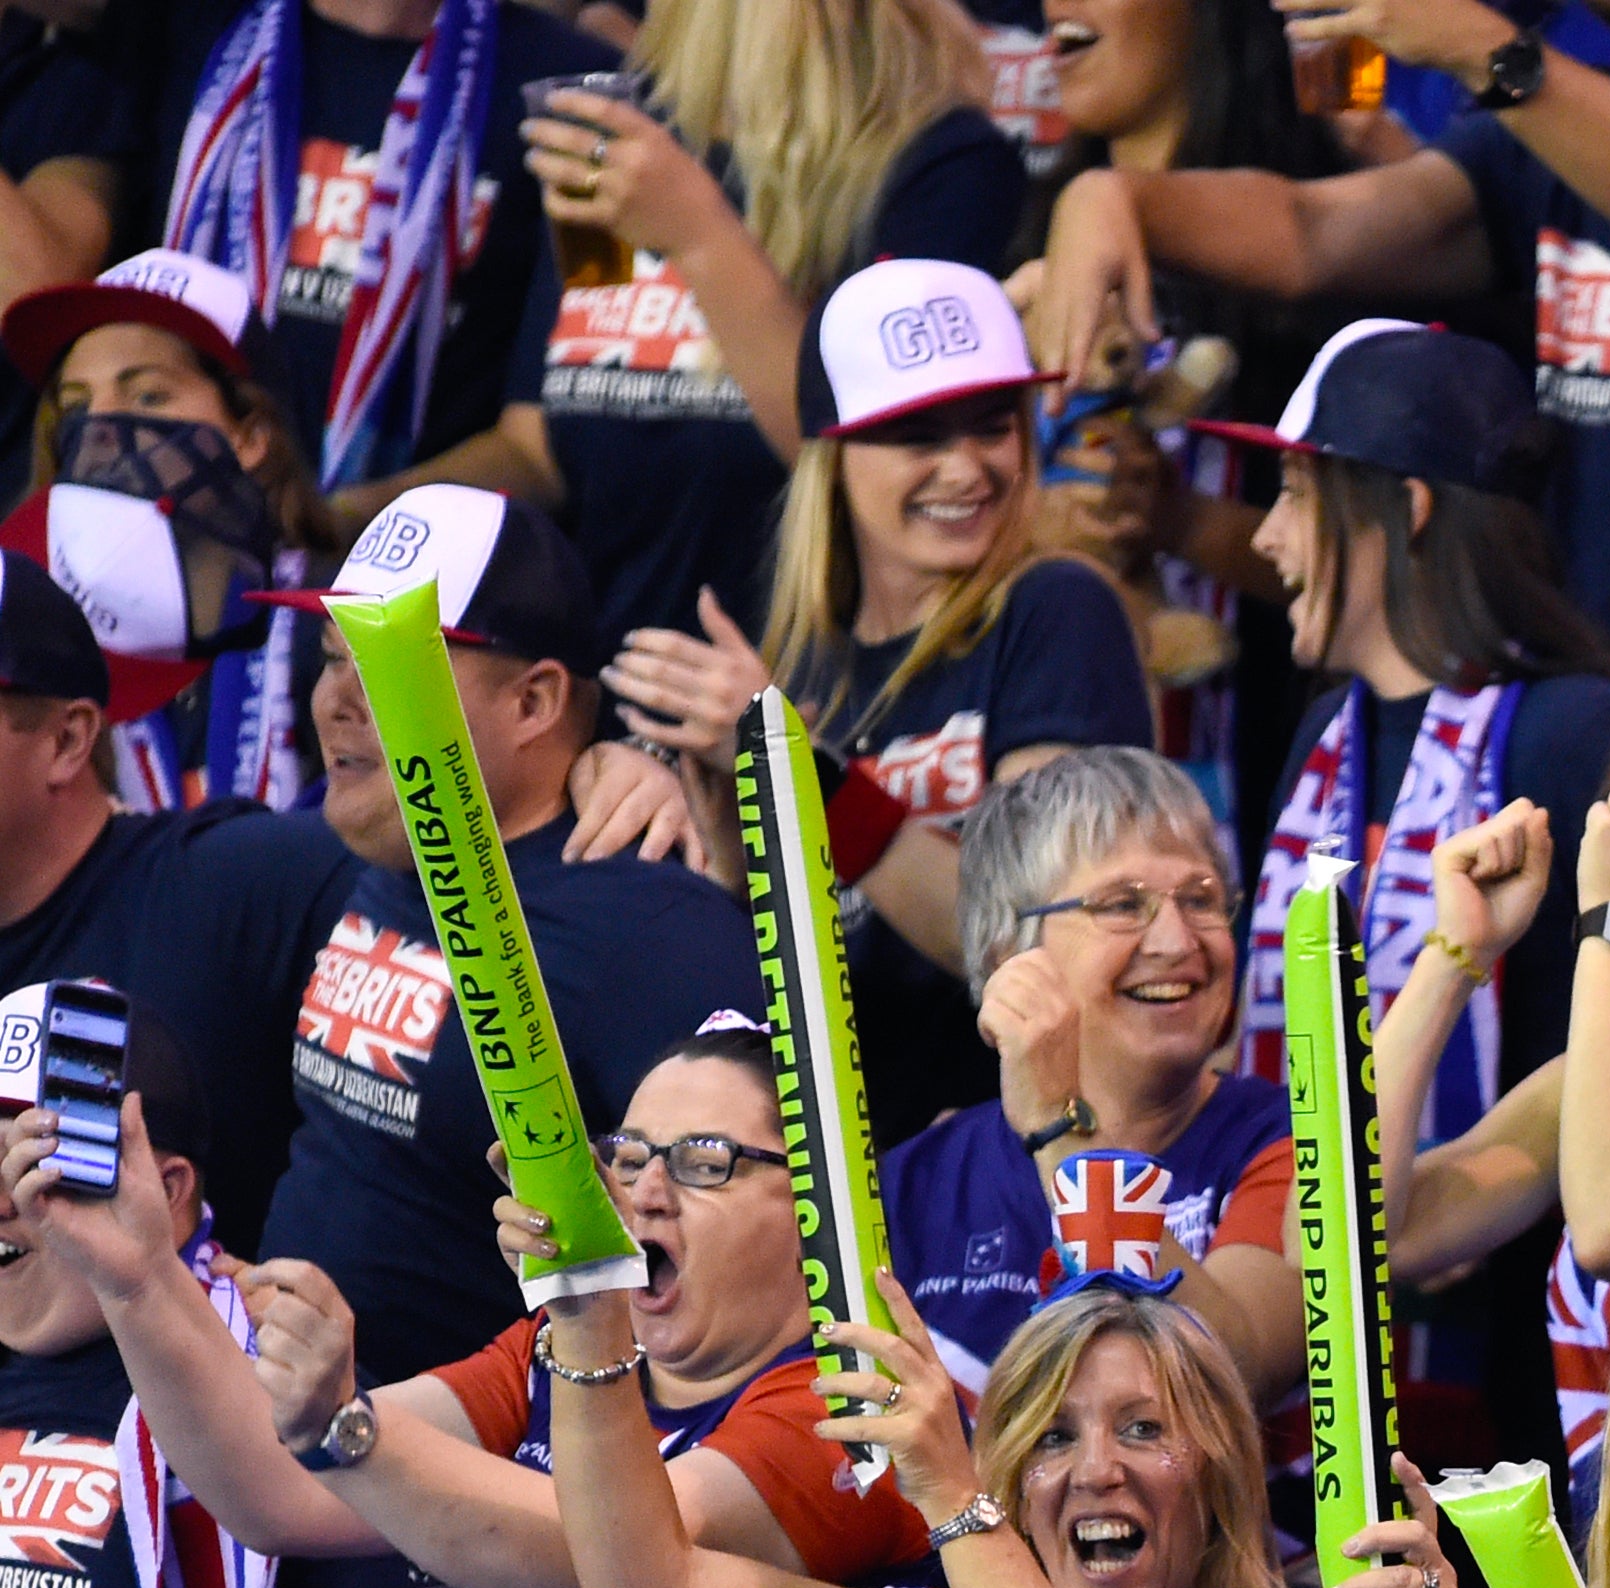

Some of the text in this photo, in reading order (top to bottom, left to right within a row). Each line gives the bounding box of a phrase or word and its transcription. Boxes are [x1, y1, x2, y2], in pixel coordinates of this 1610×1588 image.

[879, 296, 981, 370] GB
[349, 511, 432, 573] GB
[395, 754, 516, 1071] BNP PARIBAS
[440, 738, 549, 1063] The bank for a changing world
[329, 958, 443, 1041] BRITS
[343, 1069, 421, 1124] UZBEKISTAN
[915, 1270, 1040, 1299] BNP PARIBA
[1296, 1138, 1342, 1503] BNP PARIBAS
